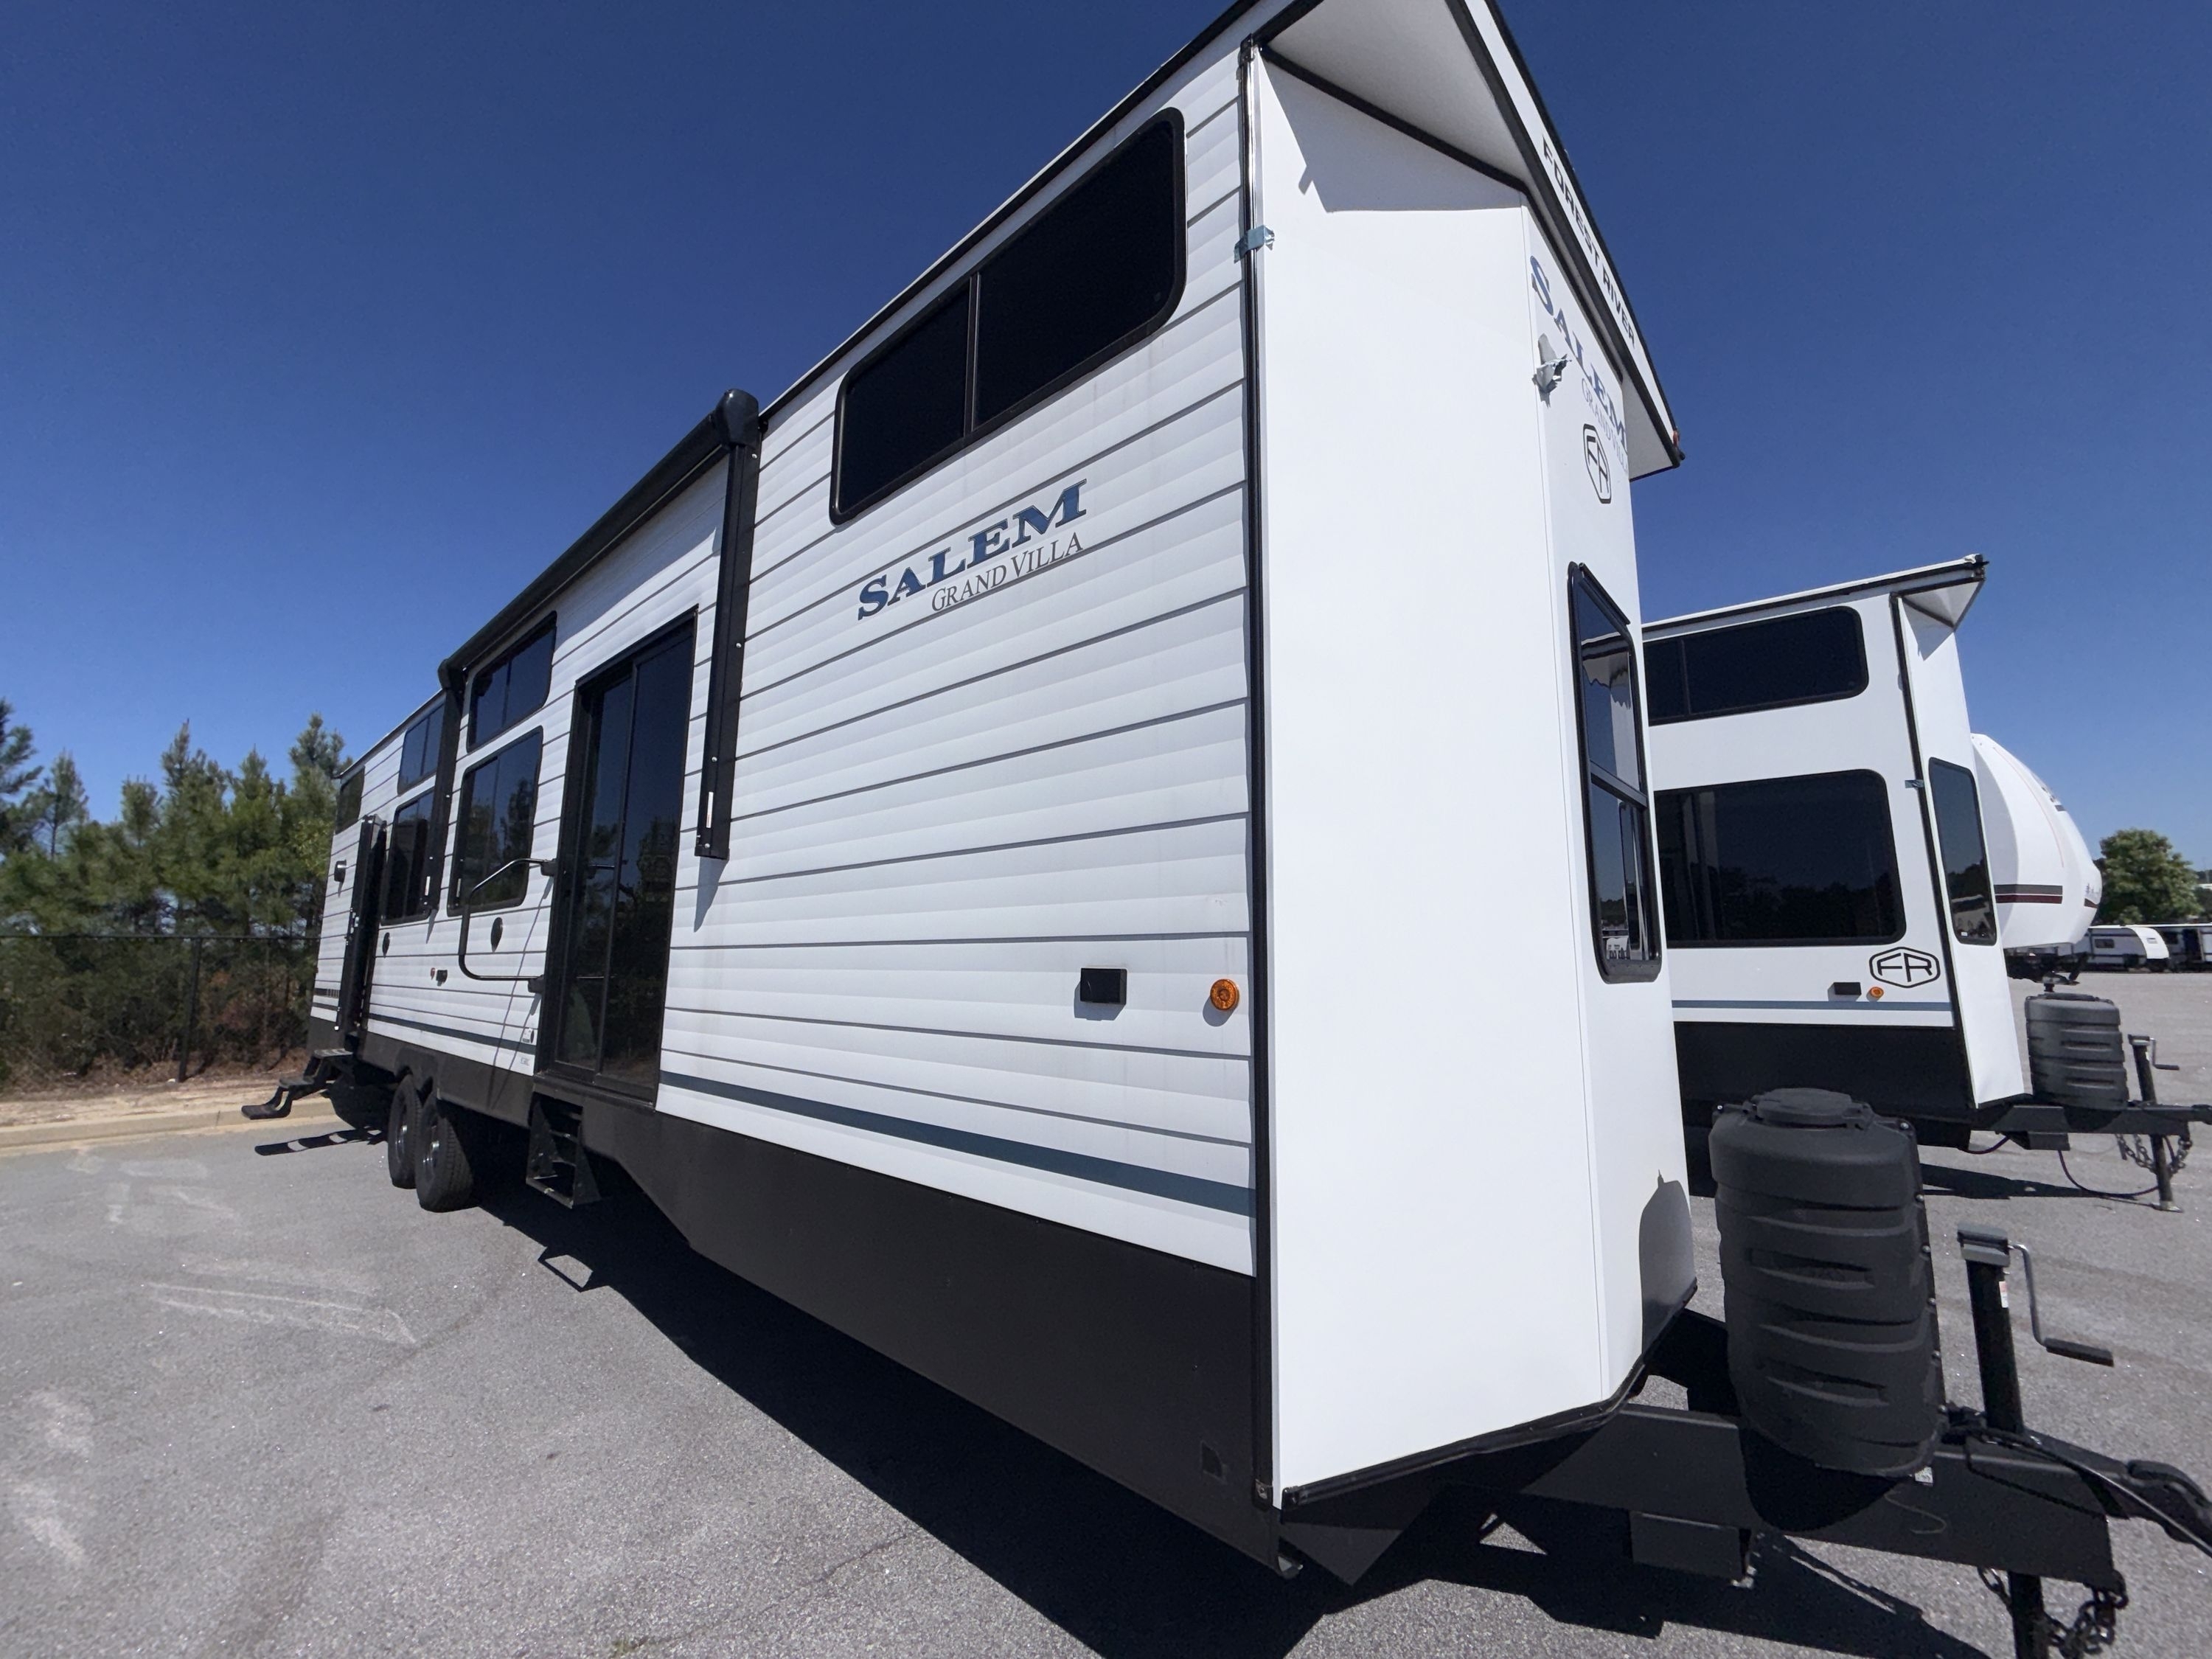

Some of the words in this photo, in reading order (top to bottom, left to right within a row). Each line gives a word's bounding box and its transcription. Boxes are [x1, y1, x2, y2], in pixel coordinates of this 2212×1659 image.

[1543, 134, 1600, 267] FOREST
[1602, 263, 1635, 349] RIVER
[1530, 256, 1628, 456] SALEM
[1582, 378, 1611, 441] GRAND
[858, 479, 1087, 621] SALEM
[931, 565, 1006, 611] GRAND
[1010, 532, 1083, 578] VILLA
[1877, 953, 1933, 982] FR
